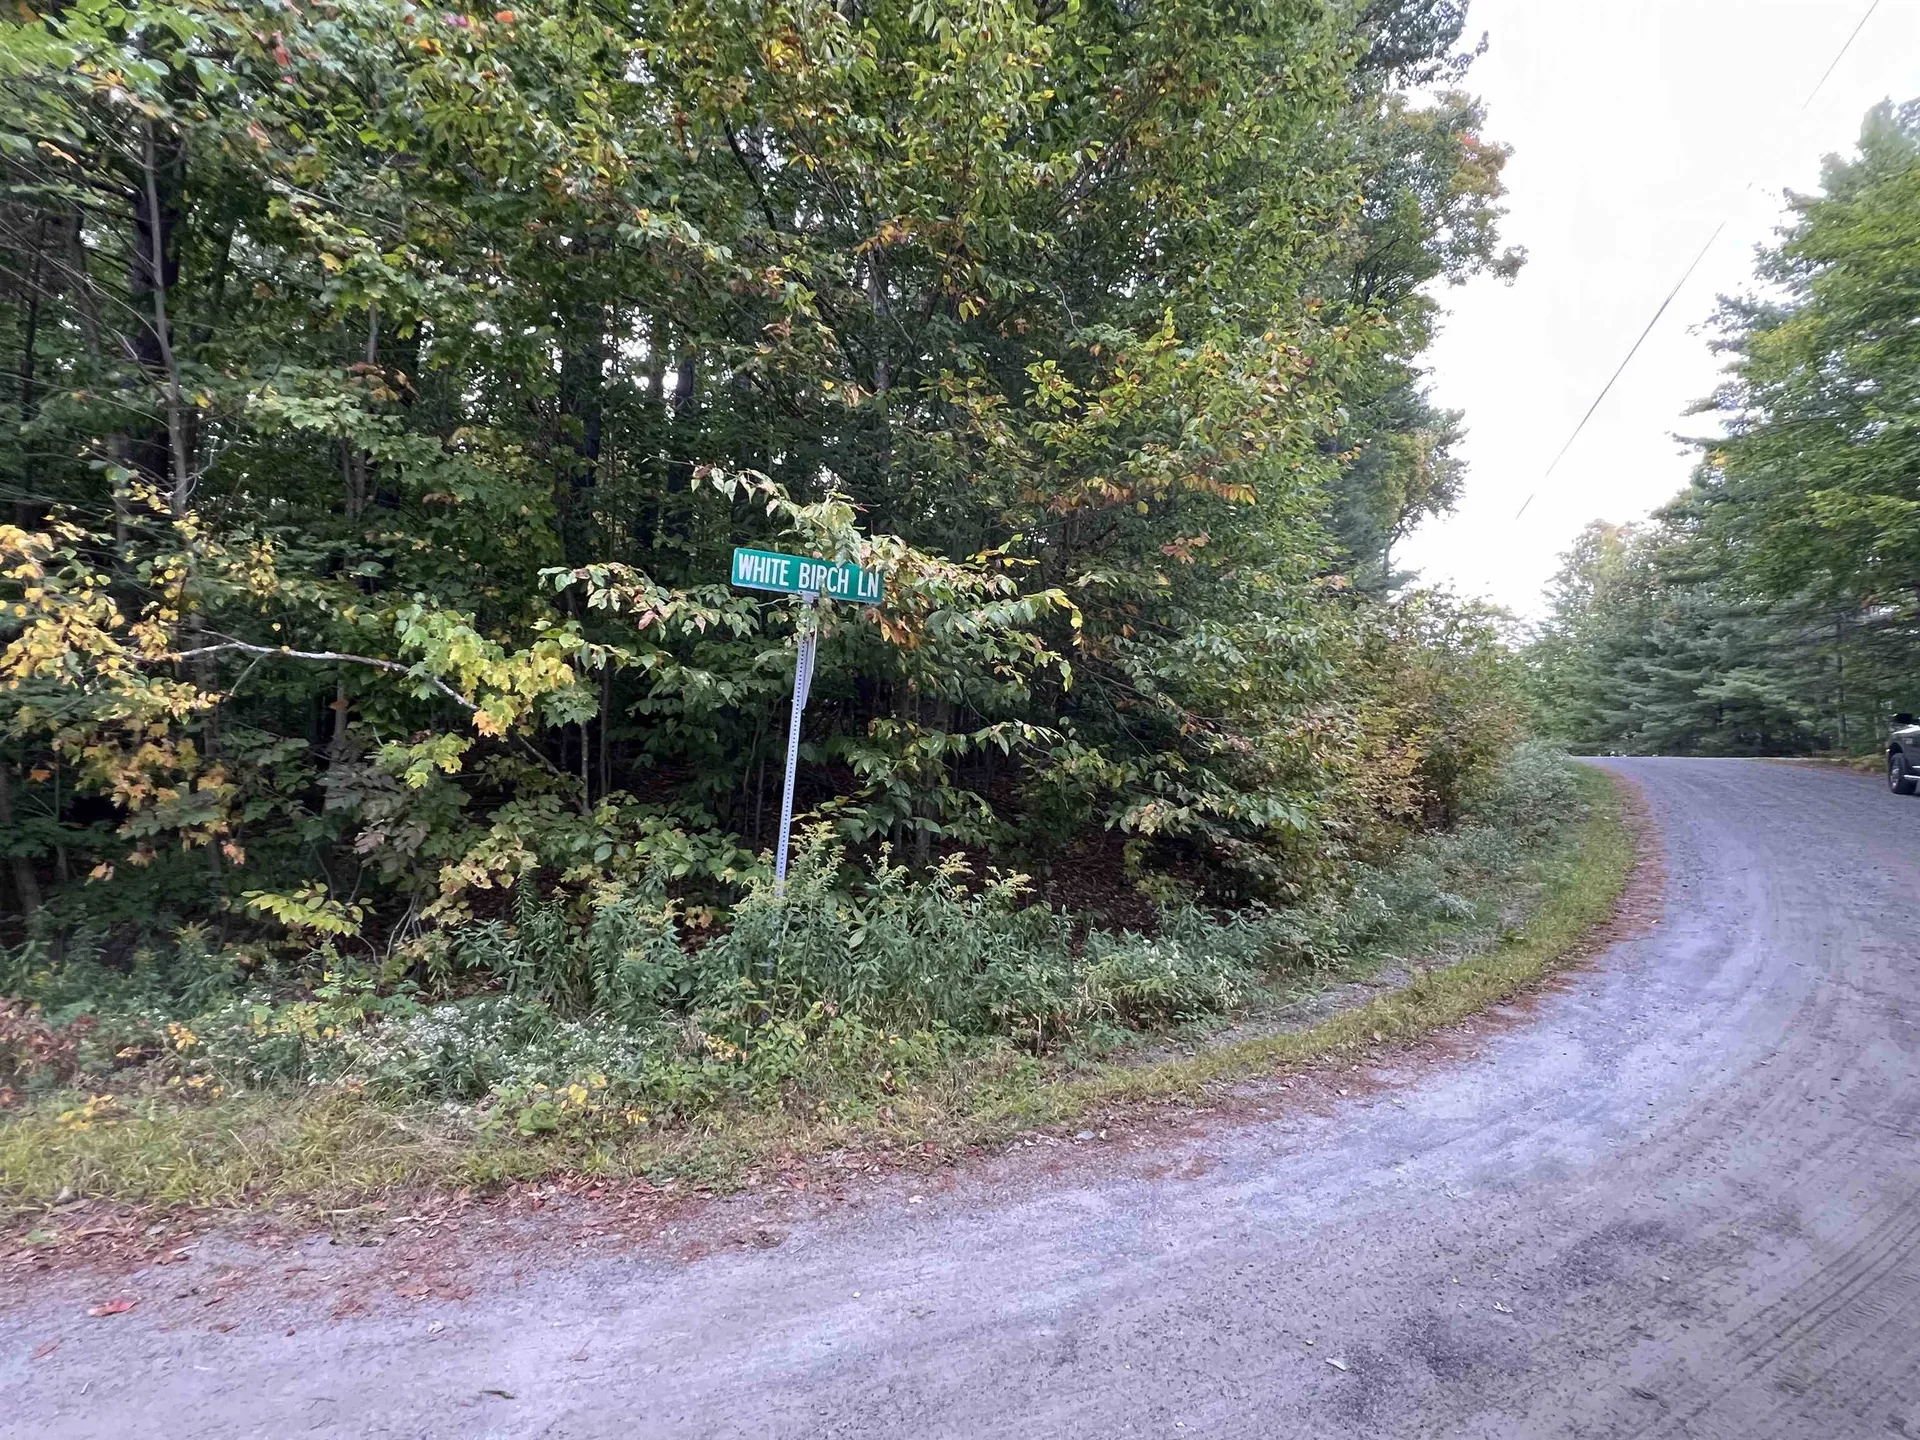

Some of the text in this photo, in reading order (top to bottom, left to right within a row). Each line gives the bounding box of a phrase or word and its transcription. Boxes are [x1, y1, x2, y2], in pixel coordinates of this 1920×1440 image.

[738, 553, 879, 598] WHITE BIRCH LN
